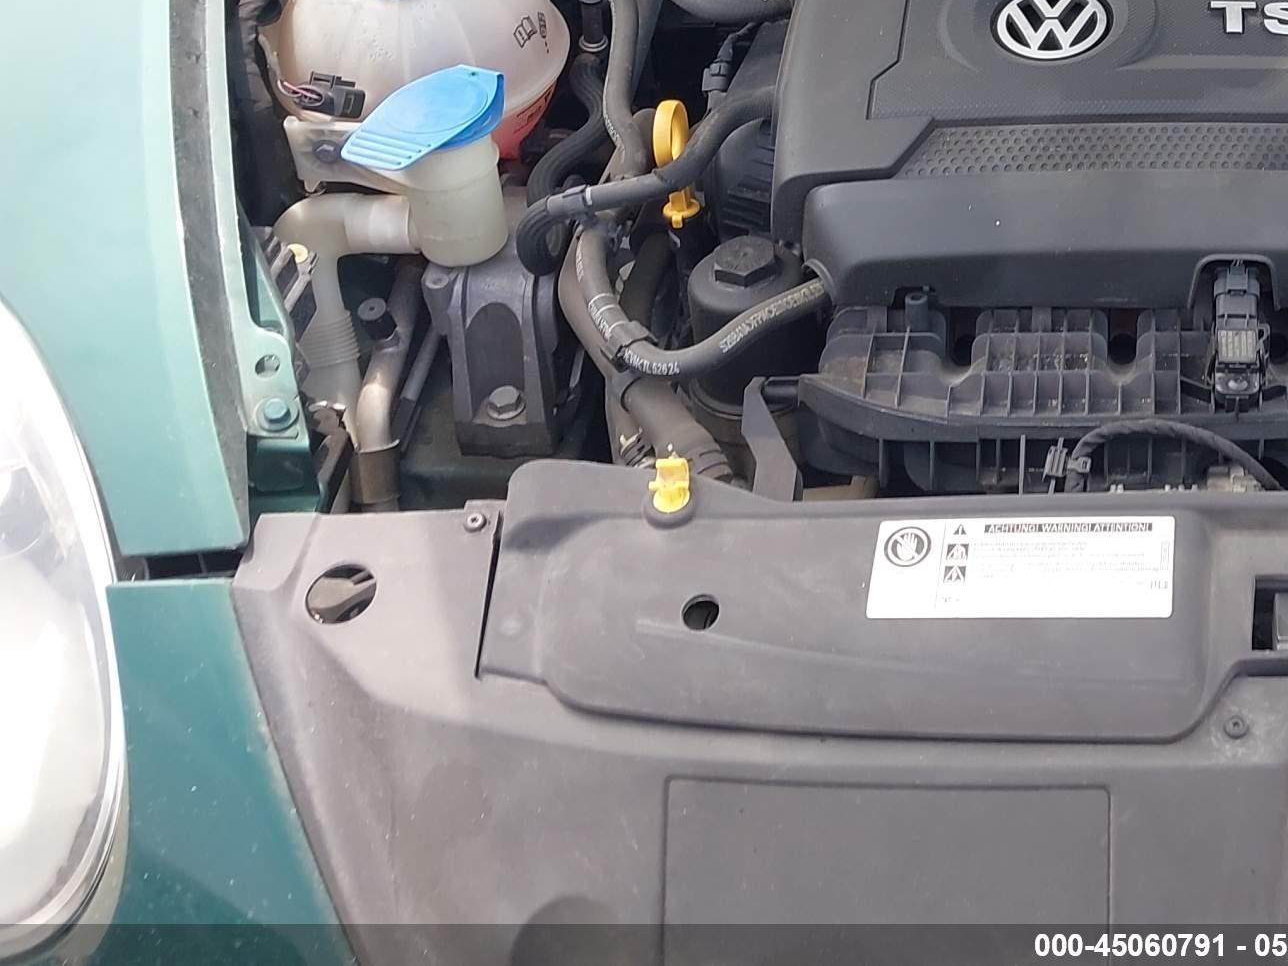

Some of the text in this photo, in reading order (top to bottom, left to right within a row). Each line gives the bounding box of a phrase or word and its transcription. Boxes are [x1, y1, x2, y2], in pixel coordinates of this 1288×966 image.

[988, 522, 1150, 533] ACHTUNG! WARNING! ATTENTION!
